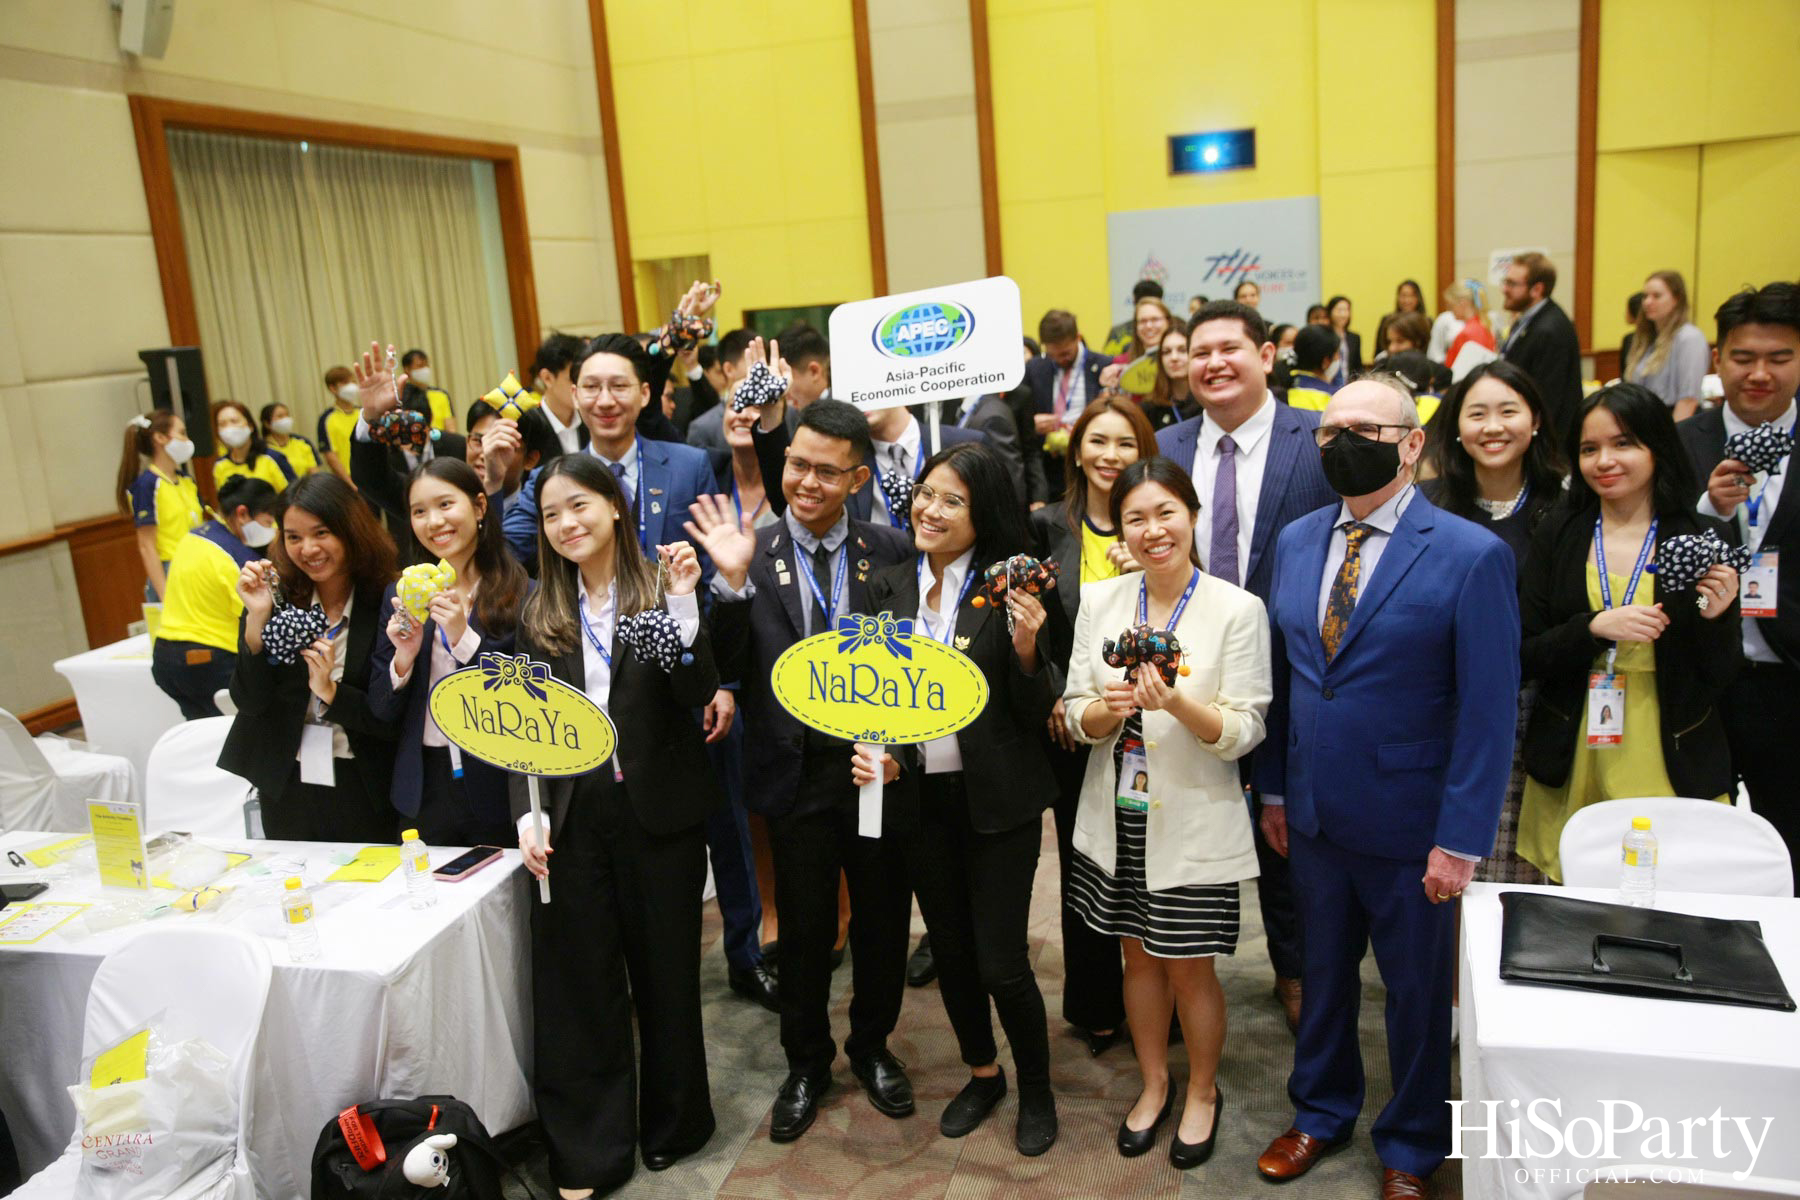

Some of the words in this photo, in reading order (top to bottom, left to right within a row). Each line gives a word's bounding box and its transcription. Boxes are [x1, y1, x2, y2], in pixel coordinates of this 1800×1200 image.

[897, 318, 950, 342] APEC
[886, 361, 966, 383] Asia-Pacific
[851, 384, 916, 403] Economic
[920, 371, 1005, 394] Cooperation
[808, 660, 947, 711] NaRaYa
[459, 693, 582, 751] NaRaYa
[81, 1133, 153, 1149] CENTARA
[96, 1146, 142, 1160] GRAND
